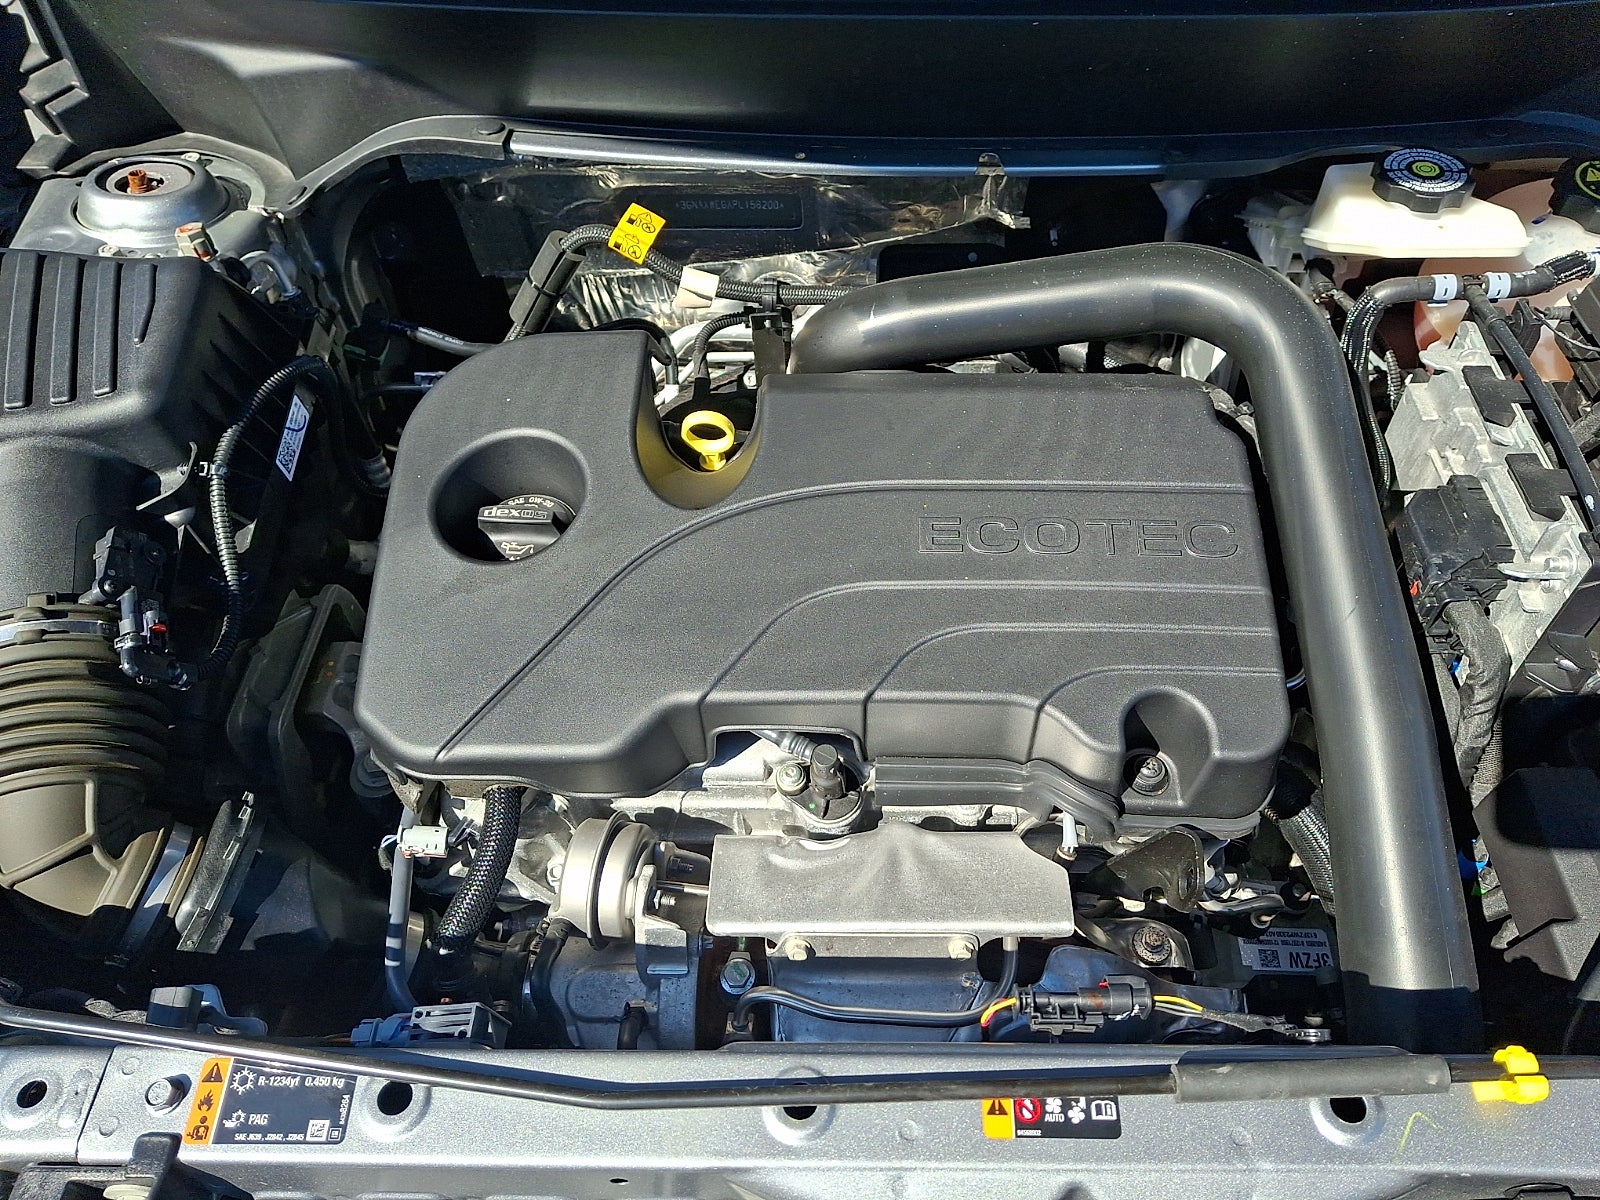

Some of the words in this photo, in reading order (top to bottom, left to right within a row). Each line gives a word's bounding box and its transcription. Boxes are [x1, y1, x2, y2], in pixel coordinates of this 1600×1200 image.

[483, 507, 548, 519] dexos
[918, 517, 1239, 558] ECOTEC
[1289, 951, 1331, 969] 3FZW
[258, 1076, 300, 1087] R-1234yf
[305, 1076, 331, 1087] 0.450
[332, 1076, 345, 1088] kg
[248, 1113, 268, 1125] PAG
[1044, 1114, 1065, 1123] AUTO
